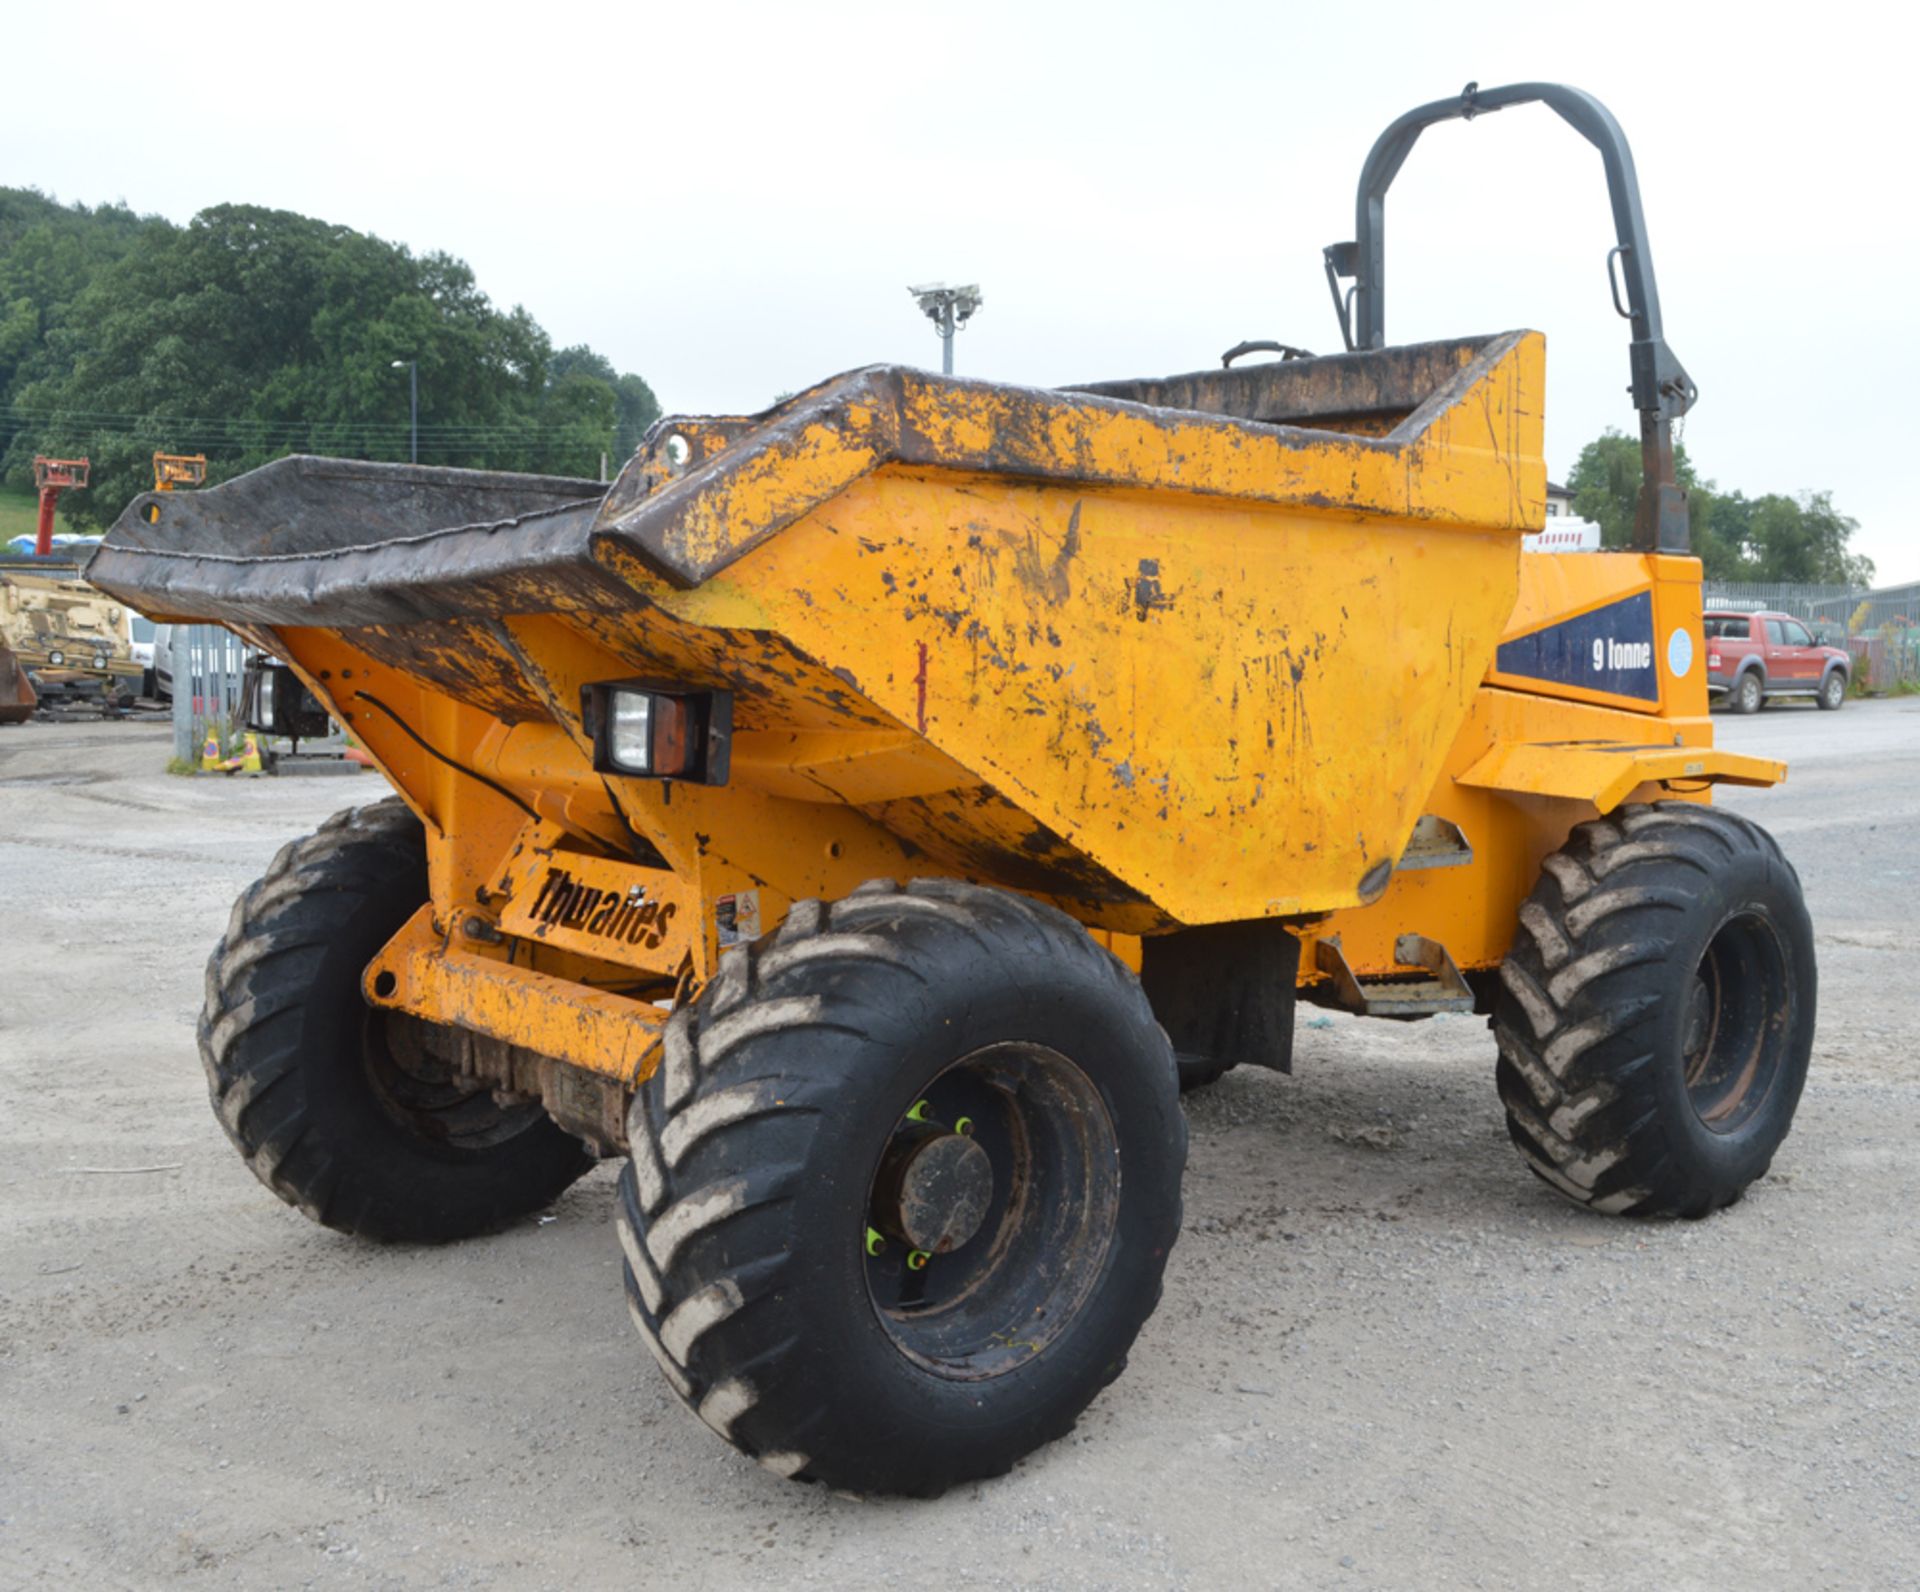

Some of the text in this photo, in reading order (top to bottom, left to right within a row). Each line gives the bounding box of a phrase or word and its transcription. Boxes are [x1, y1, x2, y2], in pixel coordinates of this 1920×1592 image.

[1593, 638, 1650, 671] 9 tonne
[529, 867, 676, 949] Thwaites
